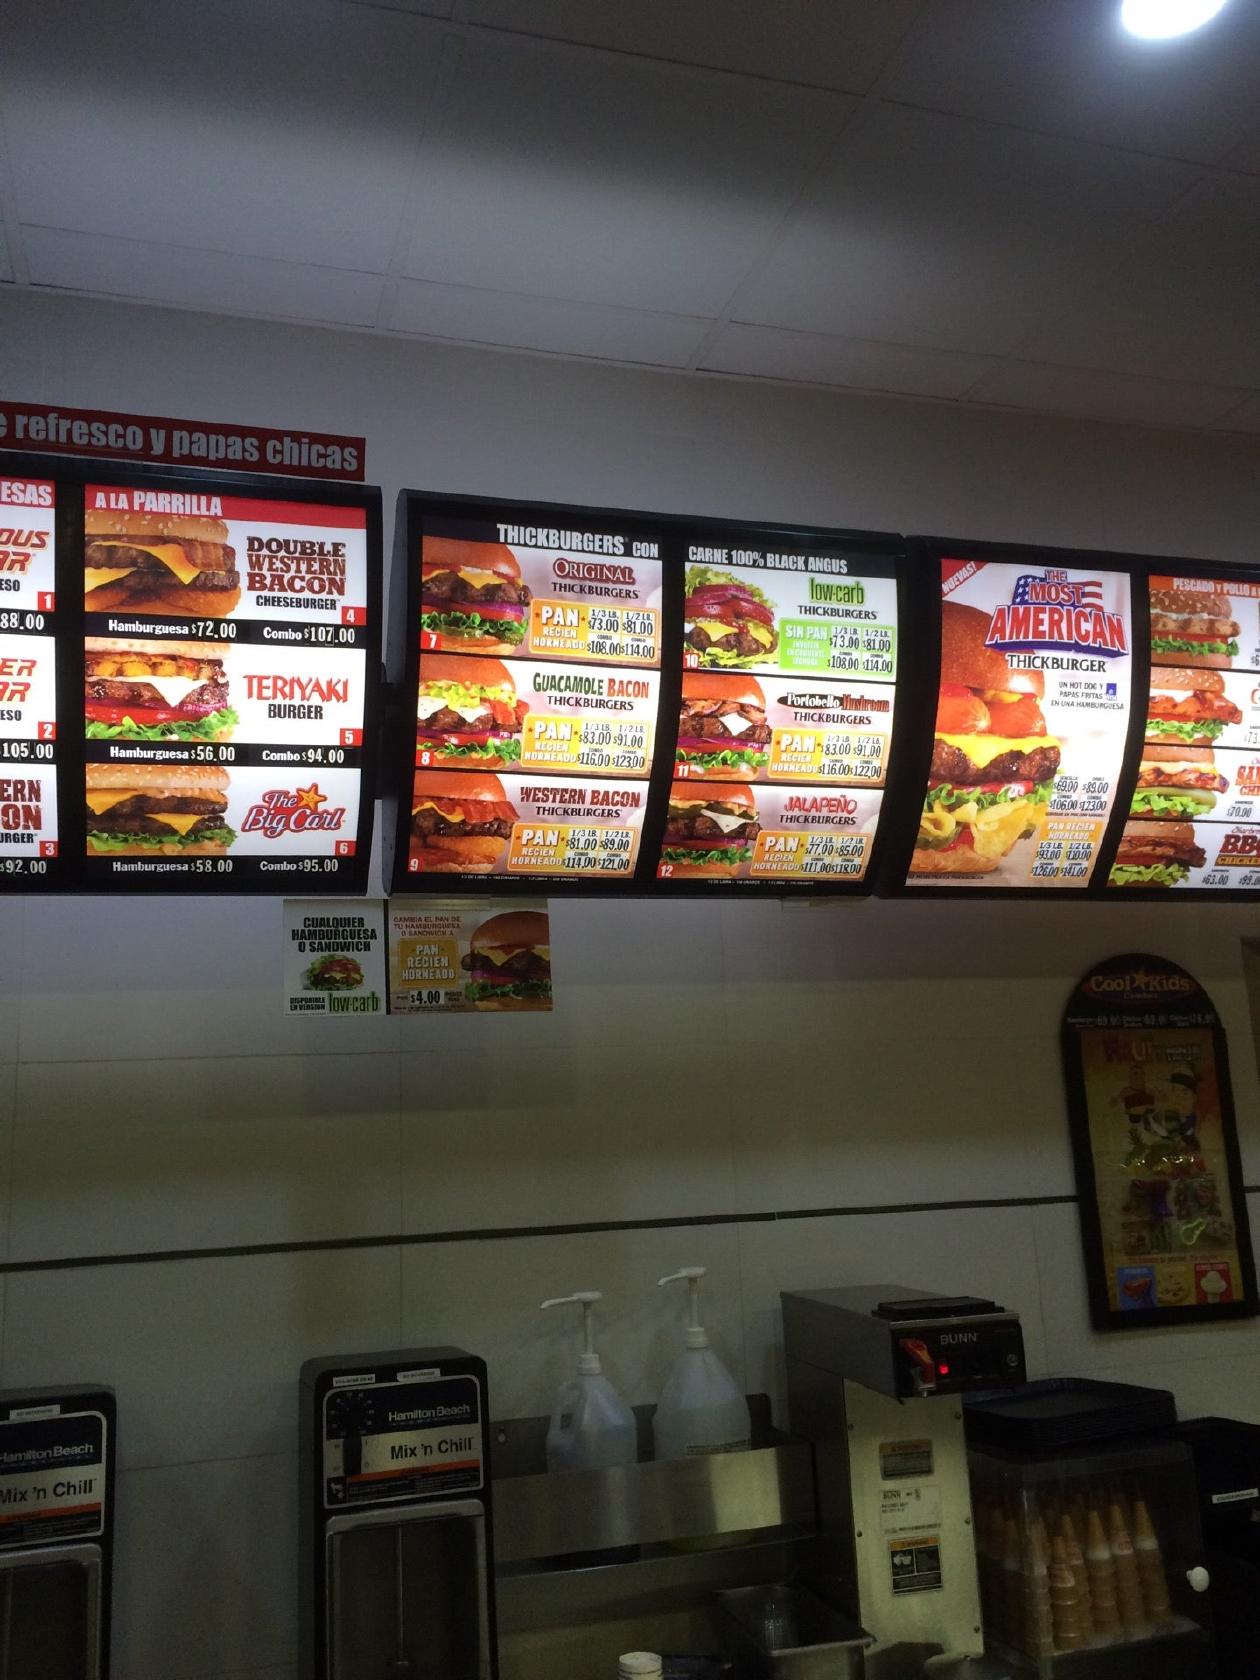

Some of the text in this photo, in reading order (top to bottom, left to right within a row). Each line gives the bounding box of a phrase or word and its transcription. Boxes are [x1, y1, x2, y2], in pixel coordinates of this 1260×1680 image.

[15, 413, 143, 450] refresco
[150, 427, 166, 456] y
[172, 428, 260, 462] papas
[266, 437, 358, 471] chicas
[95, 490, 223, 517] A LA PARRILLA
[246, 536, 346, 558] DOUBLE
[496, 524, 659, 558] THICKBURGERS CON
[246, 553, 346, 578] WESTERN
[688, 546, 848, 574] CARNE 100% BLACK ANGUS
[553, 560, 635, 584] ORIGINAL
[1045, 570, 1067, 582] THE
[246, 572, 346, 596] BACON
[552, 582, 639, 599] THICKBURGERS
[1173, 577, 1215, 593] PESCADO
[1223, 582, 1250, 596] POLLO
[44, 594, 52, 609] 1
[1029, 582, 1085, 606] MOST
[256, 595, 338, 610] CHEESEBURGER
[346, 610, 356, 623] 4
[541, 606, 581, 627] PAN
[797, 604, 878, 621] THICKBURGERS
[108, 620, 237, 639] Hamburguesa $72.00
[588, 618, 620, 633] $73.00
[622, 620, 654, 635] $81.00
[785, 625, 828, 641] SIN PAN
[986, 605, 1128, 655] AMERICAN
[263, 627, 356, 644] Combo $107.00
[429, 634, 437, 648] 7
[829, 635, 860, 650] $73.00
[620, 643, 655, 658] $114.00
[685, 654, 699, 668] 10
[1007, 654, 1107, 673] THICKBURGER
[243, 675, 349, 703] TERIYAKI
[533, 672, 650, 698] GUACAMOLE BACON
[547, 695, 635, 711] THICKBURGERS
[786, 692, 840, 710] Portobello
[1076, 701, 1124, 710] HAMBURGUESA
[268, 703, 324, 720] BURGER
[793, 711, 872, 725] THICKBURGERS
[43, 723, 53, 738] 2
[344, 730, 354, 744] 5
[534, 720, 574, 741] PAN
[578, 731, 611, 745] $83.00
[613, 733, 643, 748] $91.00
[780, 734, 817, 753] PAN
[110, 746, 236, 762] Hamburguesa $56.00
[262, 748, 345, 764] Combo $94.00
[421, 752, 431, 765] 8
[677, 765, 689, 777] 11
[264, 791, 299, 809] The
[520, 785, 641, 808] WESTERN BACON
[535, 805, 621, 818] THICKBURGERS
[783, 795, 858, 815] JALAPEÑO
[244, 804, 345, 838] Big Carl
[779, 814, 857, 826] THICKBURGERS
[521, 828, 561, 847] PAN
[565, 837, 597, 850] $81.00
[599, 838, 630, 852] $89.00
[764, 836, 801, 853] PAN
[1219, 834, 1260, 854] BB
[45, 842, 55, 856] 3
[339, 842, 349, 855] 6
[113, 860, 233, 875] Hamburguesa $58.00
[260, 859, 339, 873] Combo $95.00
[409, 858, 419, 871] 9
[660, 863, 674, 877] 12
[304, 917, 365, 929] CUALQUIER
[291, 929, 378, 941] HAMBURGUESA
[298, 941, 371, 953] O SANDWICH
[415, 944, 440, 956] PAN
[401, 969, 455, 981] HORNEADO
[1089, 975, 1191, 992] Cool Kids
[411, 990, 440, 1004] $4.00
[939, 1332, 977, 1345] BUNN
[390, 1444, 417, 1460] Mix
[438, 1437, 472, 1454] Chill
[53, 1479, 93, 1498] Chill
